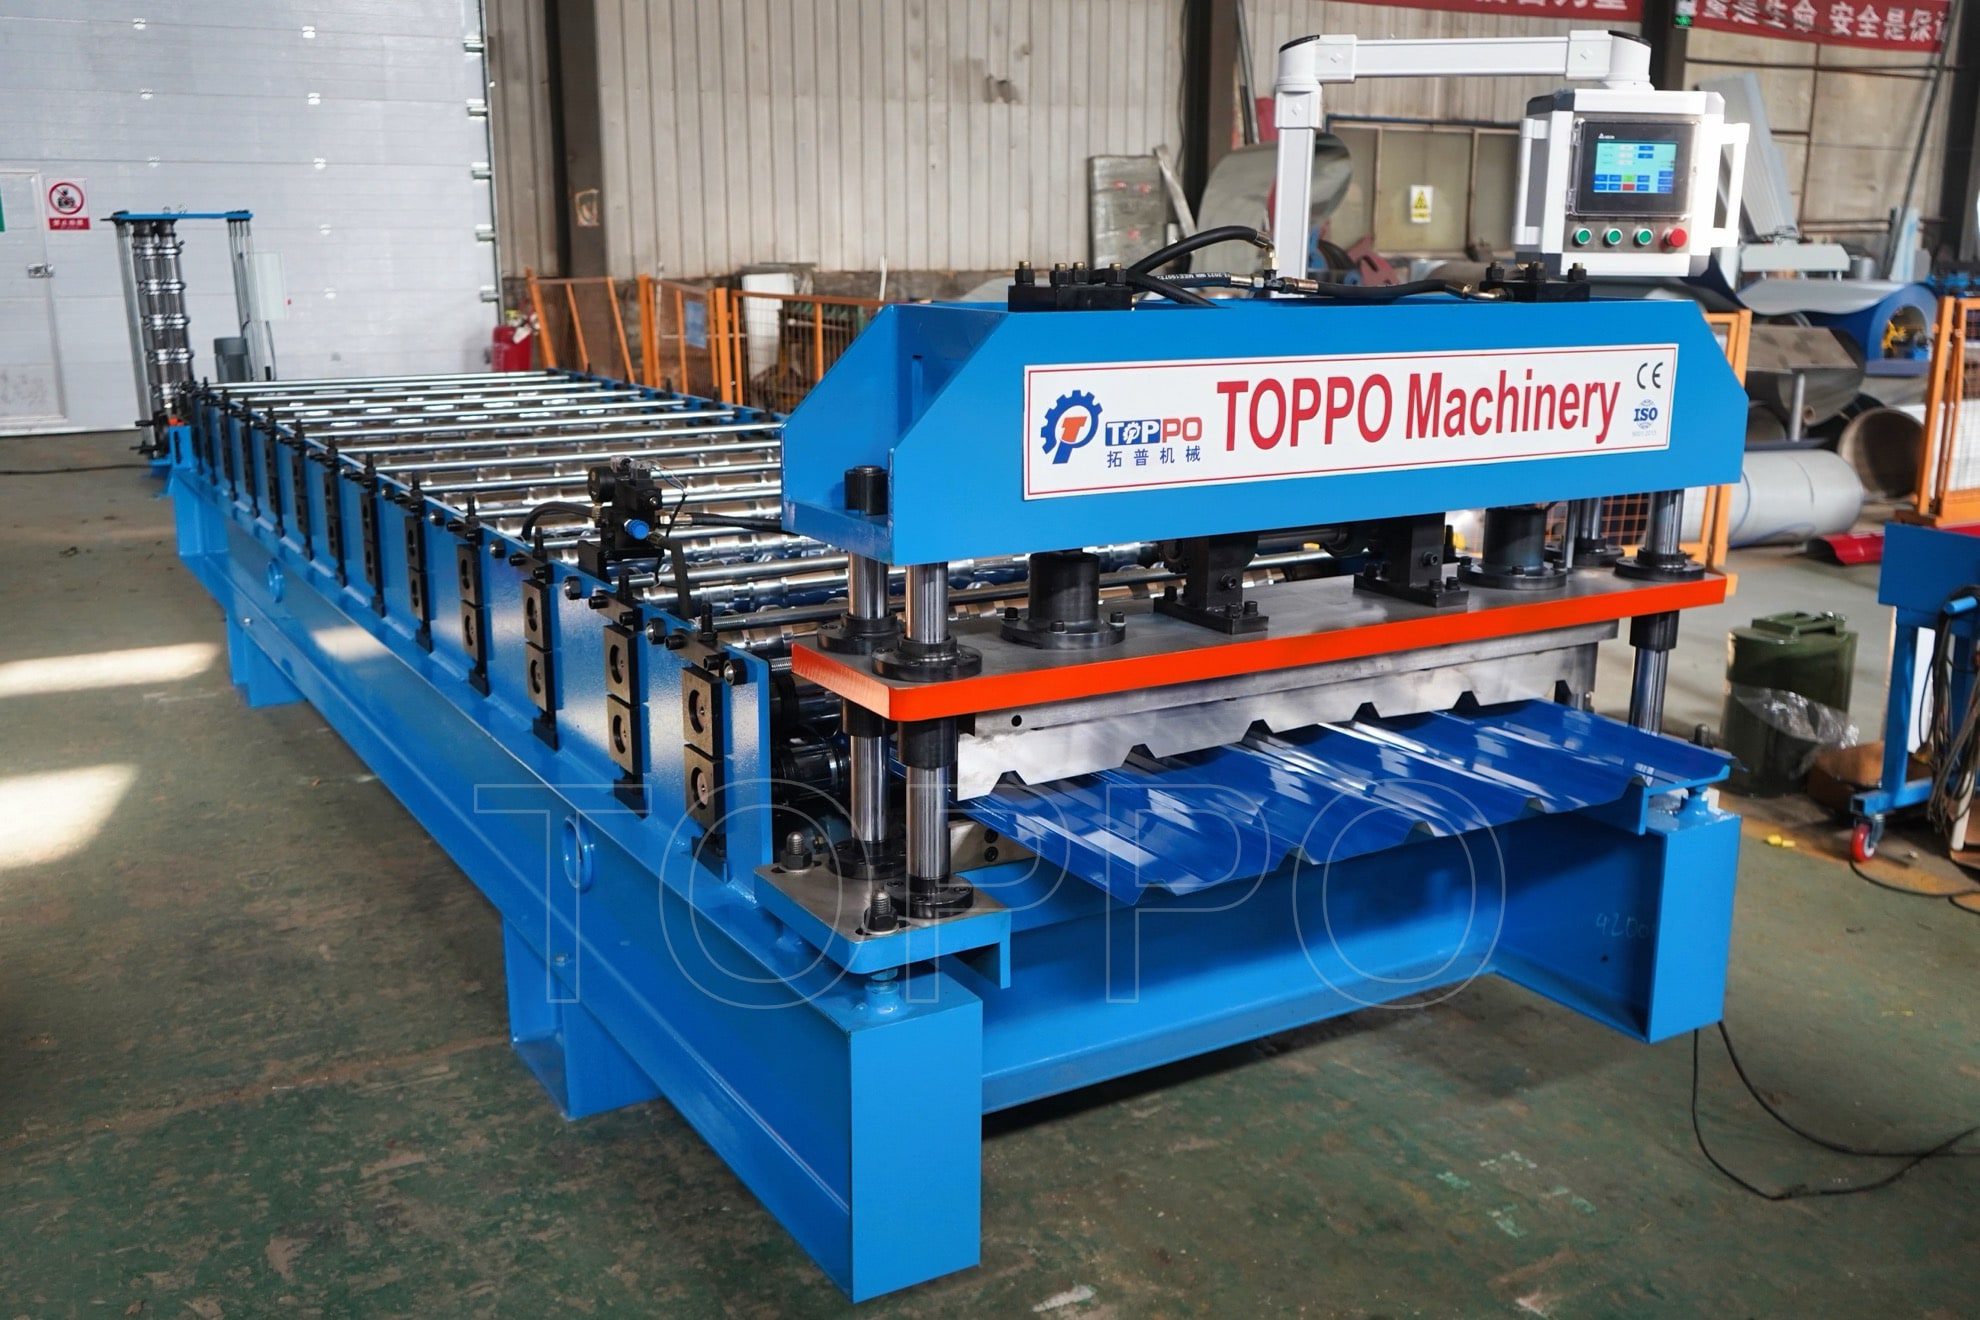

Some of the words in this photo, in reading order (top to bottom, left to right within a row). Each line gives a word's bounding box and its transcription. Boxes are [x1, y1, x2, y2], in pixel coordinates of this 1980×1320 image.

[1636, 361, 1663, 390] CE
[1217, 373, 1394, 452] TOPPO
[1405, 368, 1621, 444] Machinery
[1633, 406, 1659, 422] ISO
[1105, 416, 1203, 447] TOPPO
[1106, 445, 1201, 469] 拓普机械
